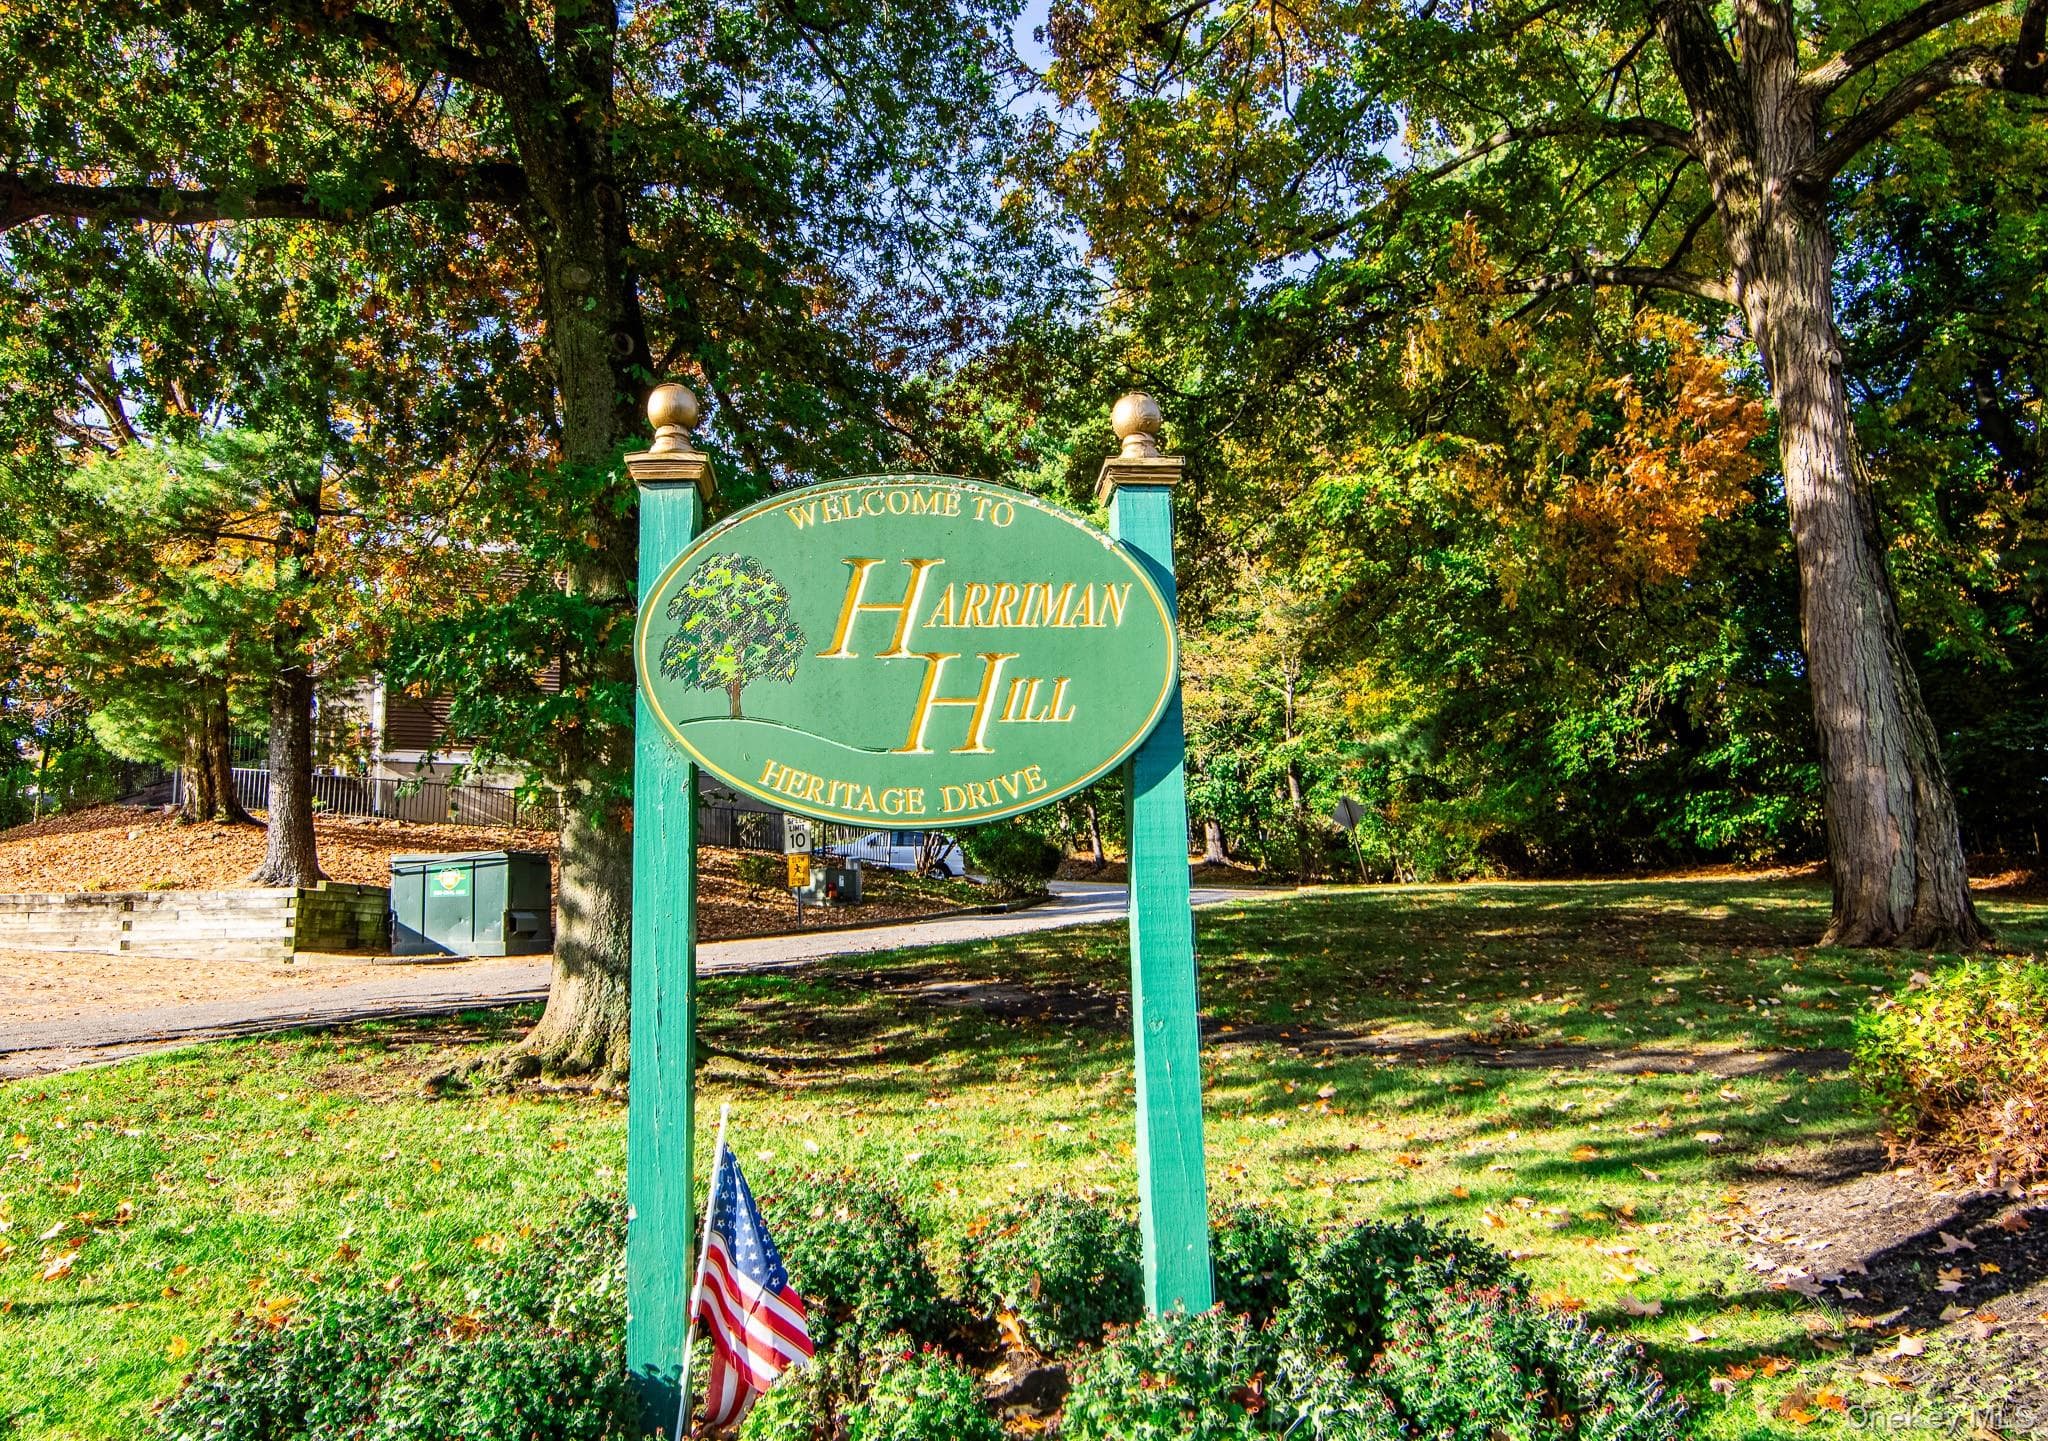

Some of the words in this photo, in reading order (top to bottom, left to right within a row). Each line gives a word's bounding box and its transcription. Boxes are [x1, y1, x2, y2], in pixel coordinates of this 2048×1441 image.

[784, 488, 962, 530] WELCOME
[972, 495, 1015, 528] TO
[815, 557, 1133, 660] HARRIMAN
[889, 652, 1076, 755] HILL
[758, 759, 926, 815] HERITAGE
[938, 764, 1048, 813] DRIVE
[789, 824, 805, 832] LIMIT
[790, 832, 806, 849] 10
